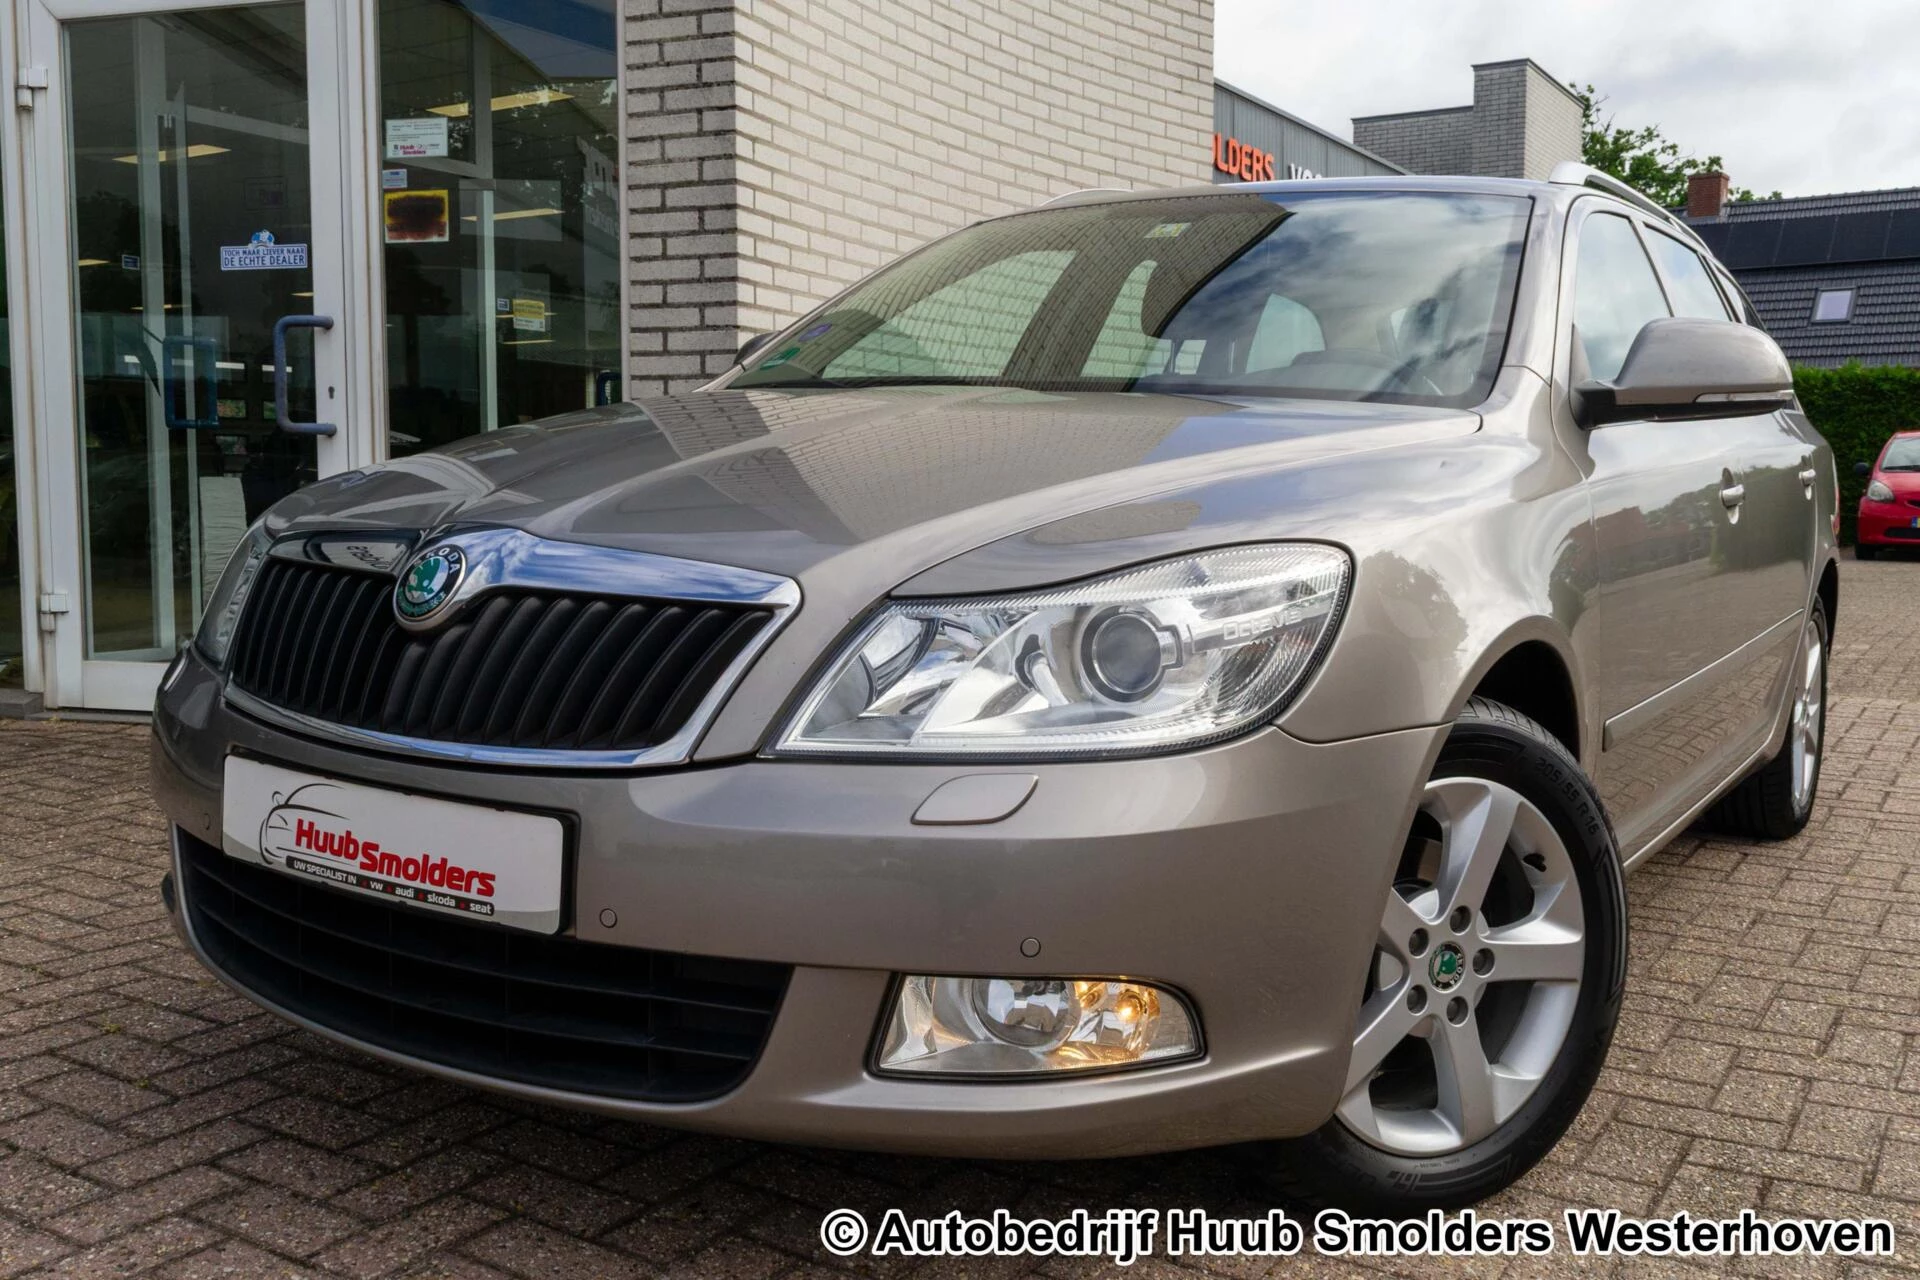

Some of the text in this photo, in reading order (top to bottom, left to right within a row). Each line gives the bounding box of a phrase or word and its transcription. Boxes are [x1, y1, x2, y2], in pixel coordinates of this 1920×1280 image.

[1212, 132, 1275, 182] LDERS
[224, 247, 305, 257] TOCH MAAR LIEVER NAAR
[224, 255, 305, 266] DE ECHTE DEALER
[293, 860, 306, 871] UW
[306, 864, 348, 882] SPECIALIST
[348, 876, 357, 885] IN
[395, 886, 415, 899] audi
[427, 892, 456, 907] skoda
[469, 901, 492, 914] seat
